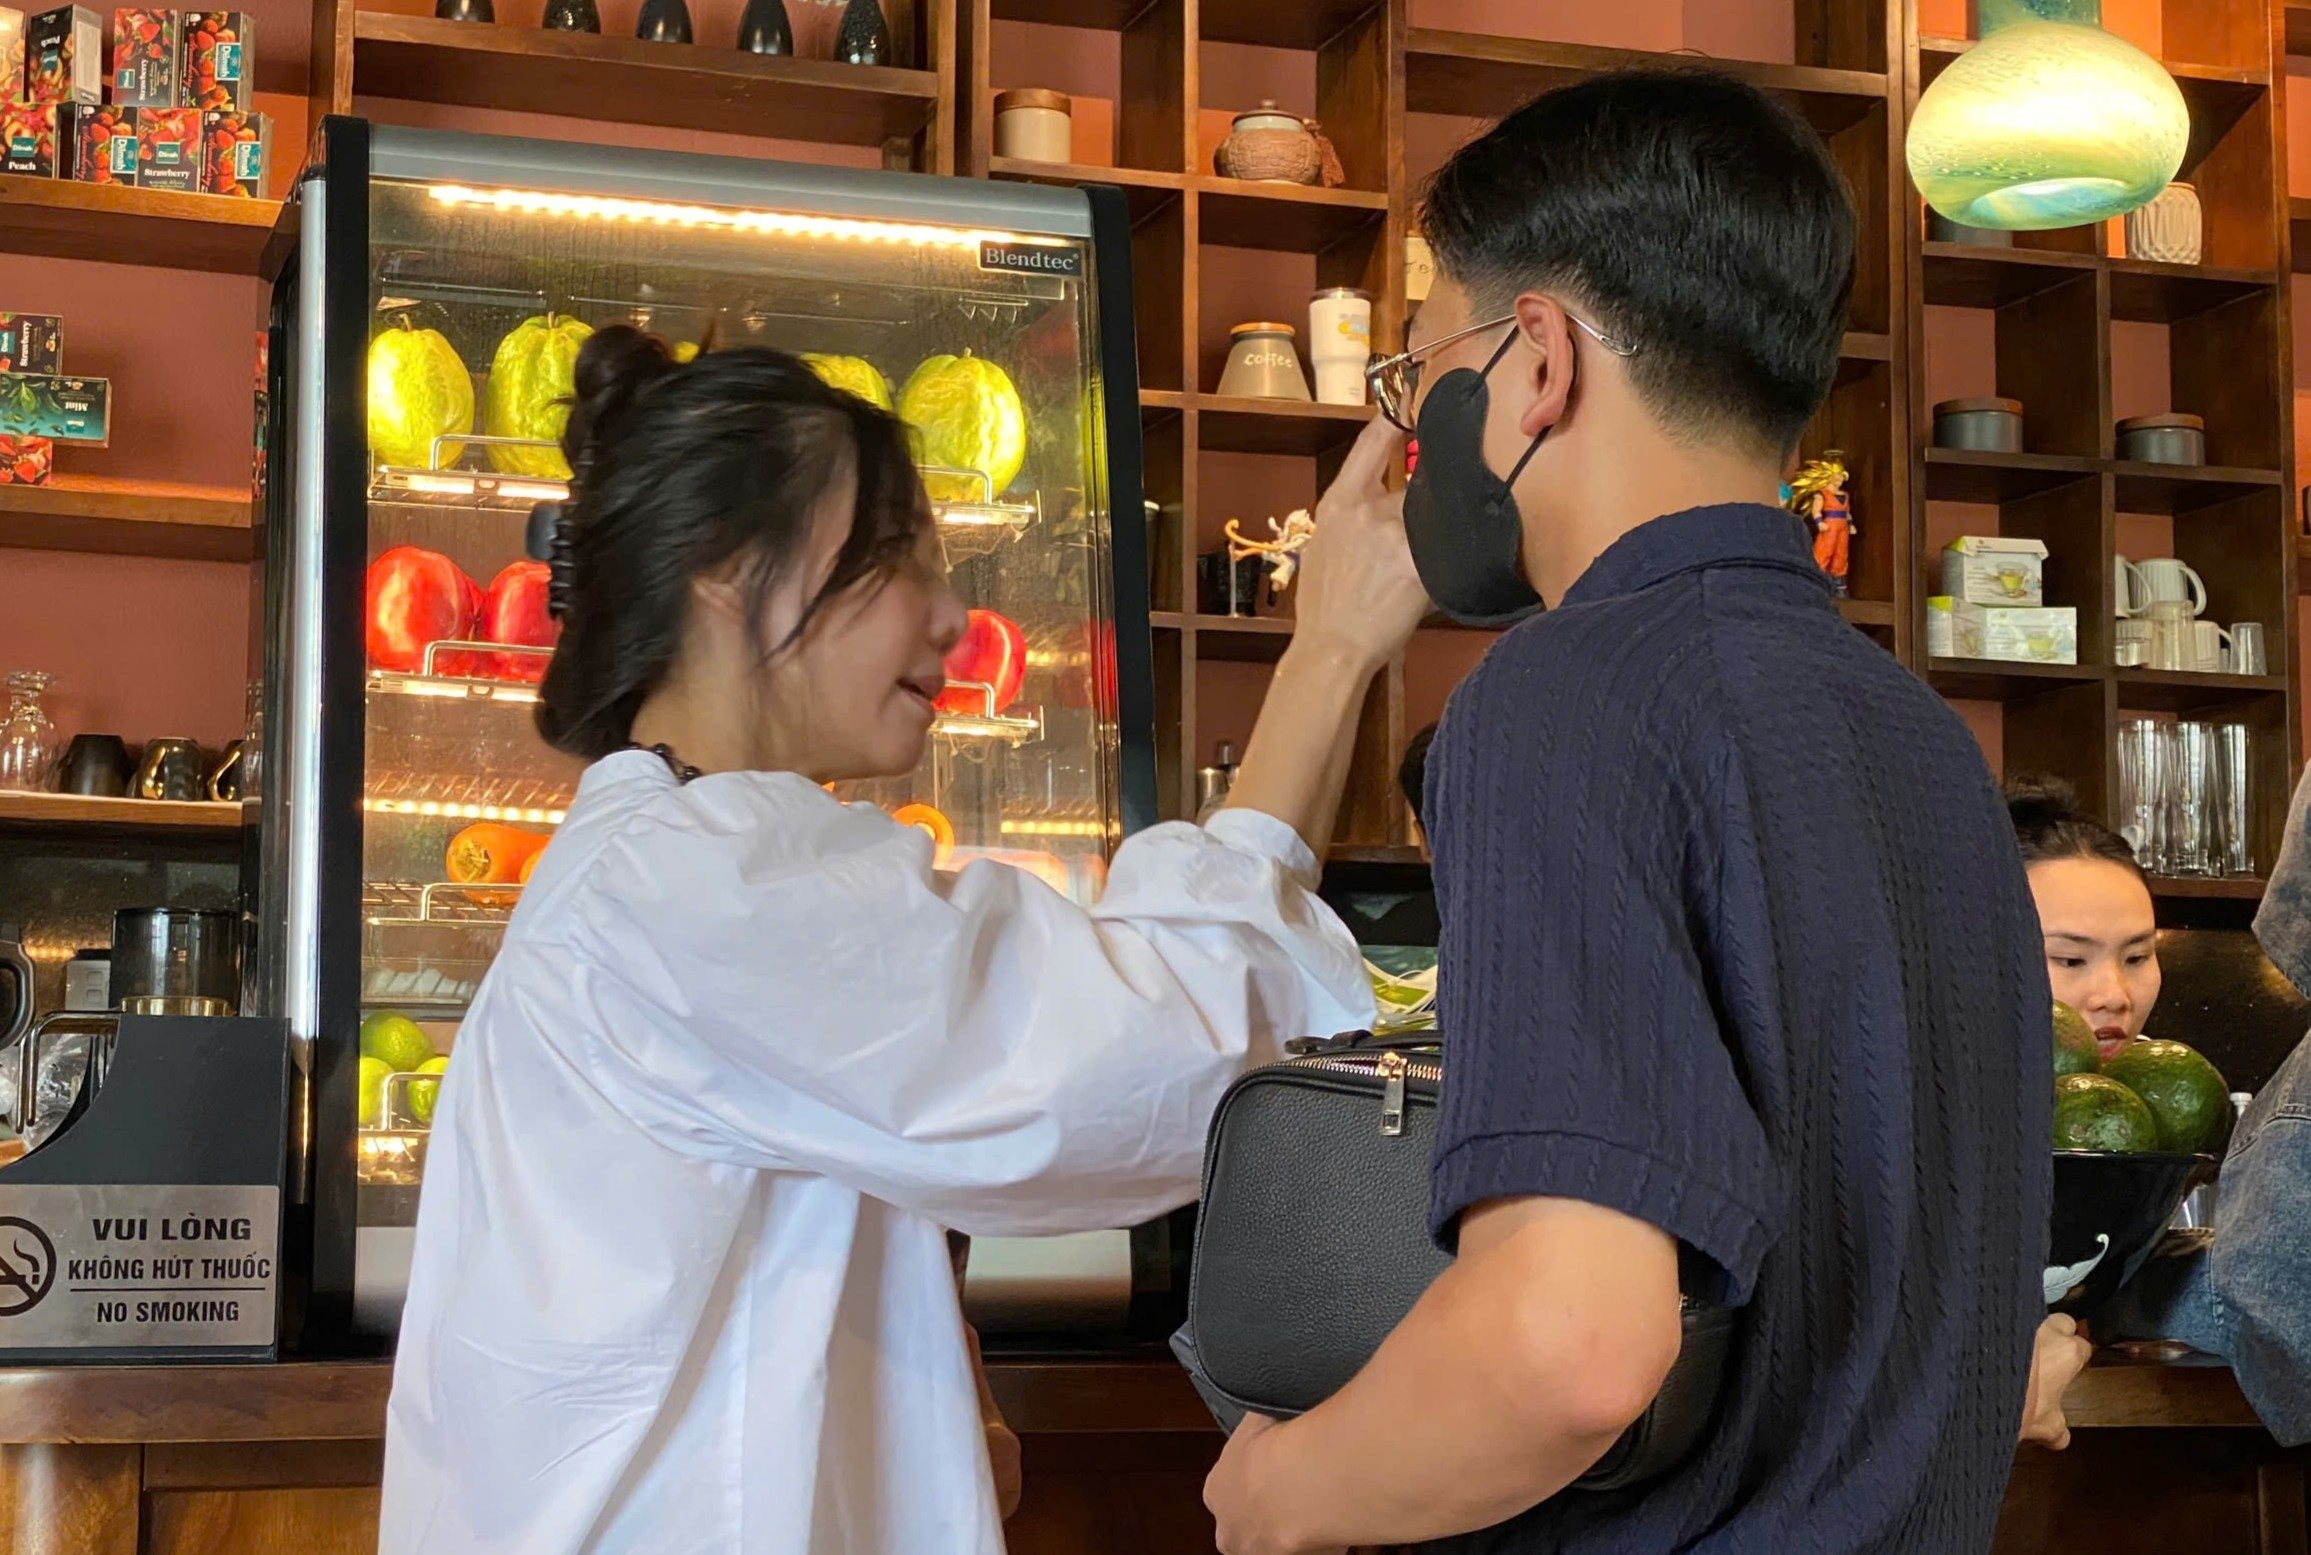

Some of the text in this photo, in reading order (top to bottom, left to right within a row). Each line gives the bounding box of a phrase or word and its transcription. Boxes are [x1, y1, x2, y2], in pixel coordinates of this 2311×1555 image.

[219, 46, 231, 77] Dilmah
[139, 59, 149, 101] Strawberry
[8, 161, 36, 170] Peach
[116, 139, 127, 171] Dilmah
[241, 144, 250, 176] Dilmah
[144, 168, 190, 179] Strawberry
[986, 248, 1074, 270] Blendtec
[20, 320, 32, 366] Strawberry
[65, 402, 88, 411] Mint
[93, 1212, 251, 1240] VUI LÒNG
[68, 1252, 270, 1280] KHÔNG HÚT THUỐC
[97, 1301, 239, 1323] NO SMOKING
